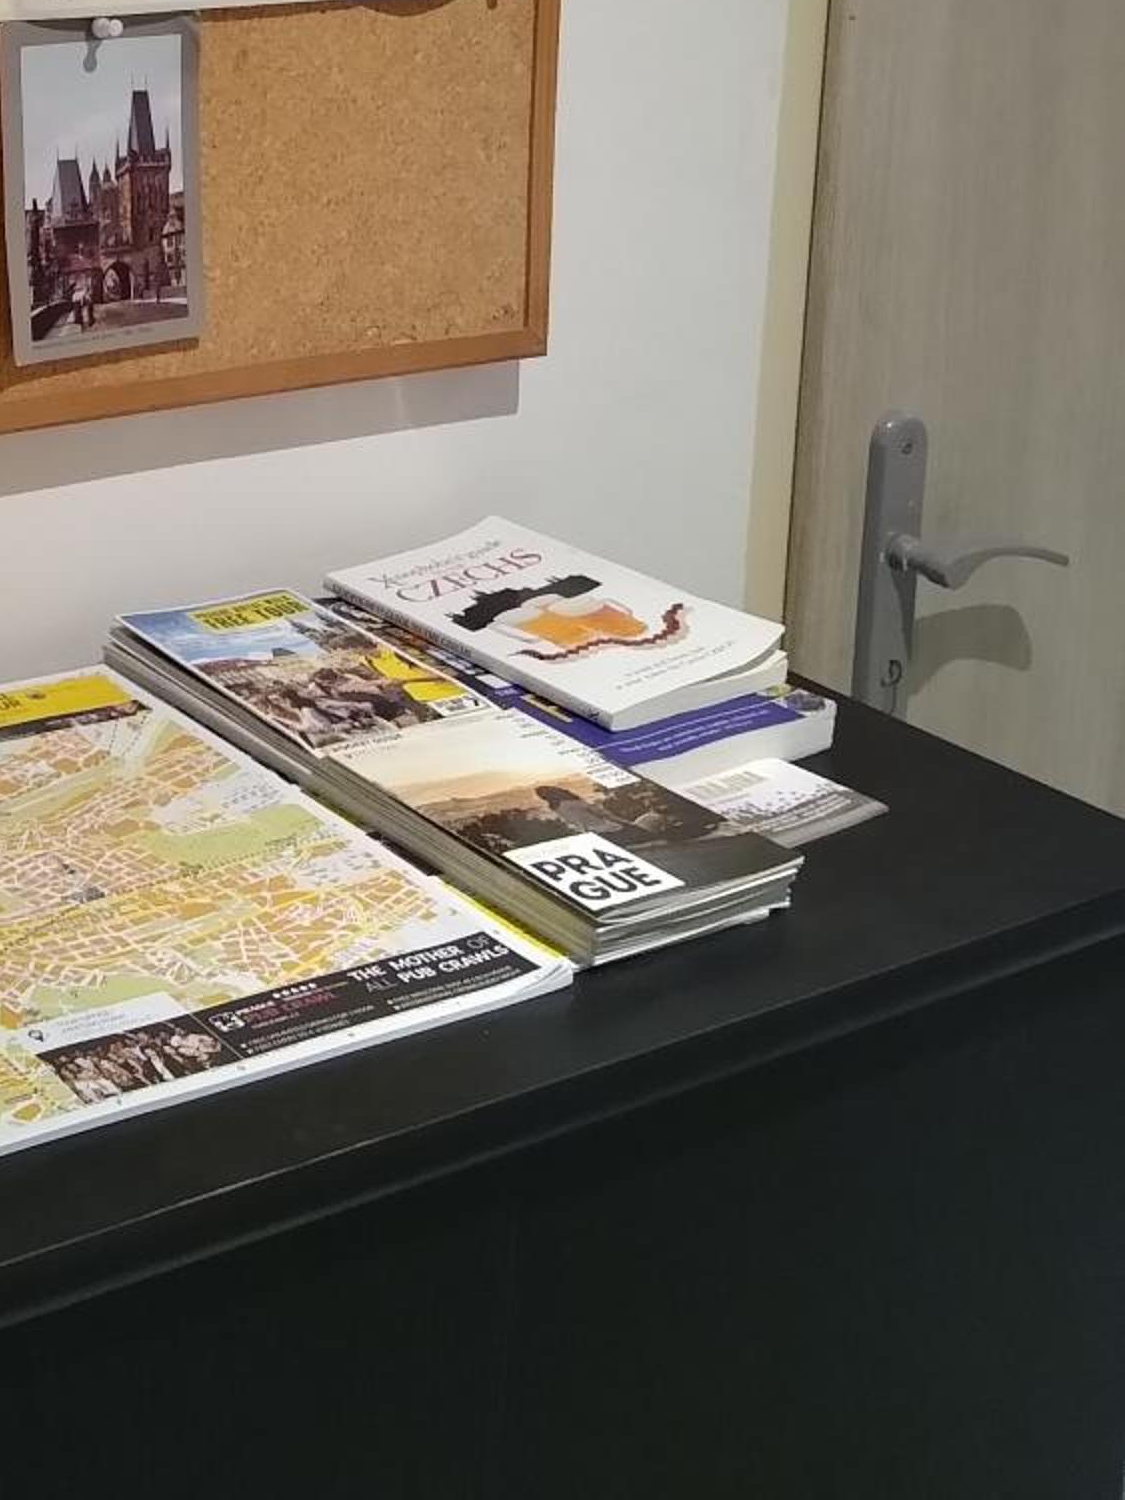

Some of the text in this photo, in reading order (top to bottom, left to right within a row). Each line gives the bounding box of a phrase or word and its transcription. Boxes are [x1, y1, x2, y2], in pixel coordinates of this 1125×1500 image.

[395, 548, 543, 603] CZECHS
[255, 601, 310, 620] TOUR
[528, 848, 635, 882] PRA
[568, 866, 662, 901] GUE
[346, 935, 490, 982] THE MOTHER OF
[365, 977, 398, 994] ALL
[396, 965, 437, 984] PUB
[437, 944, 510, 974] CRAWLS
